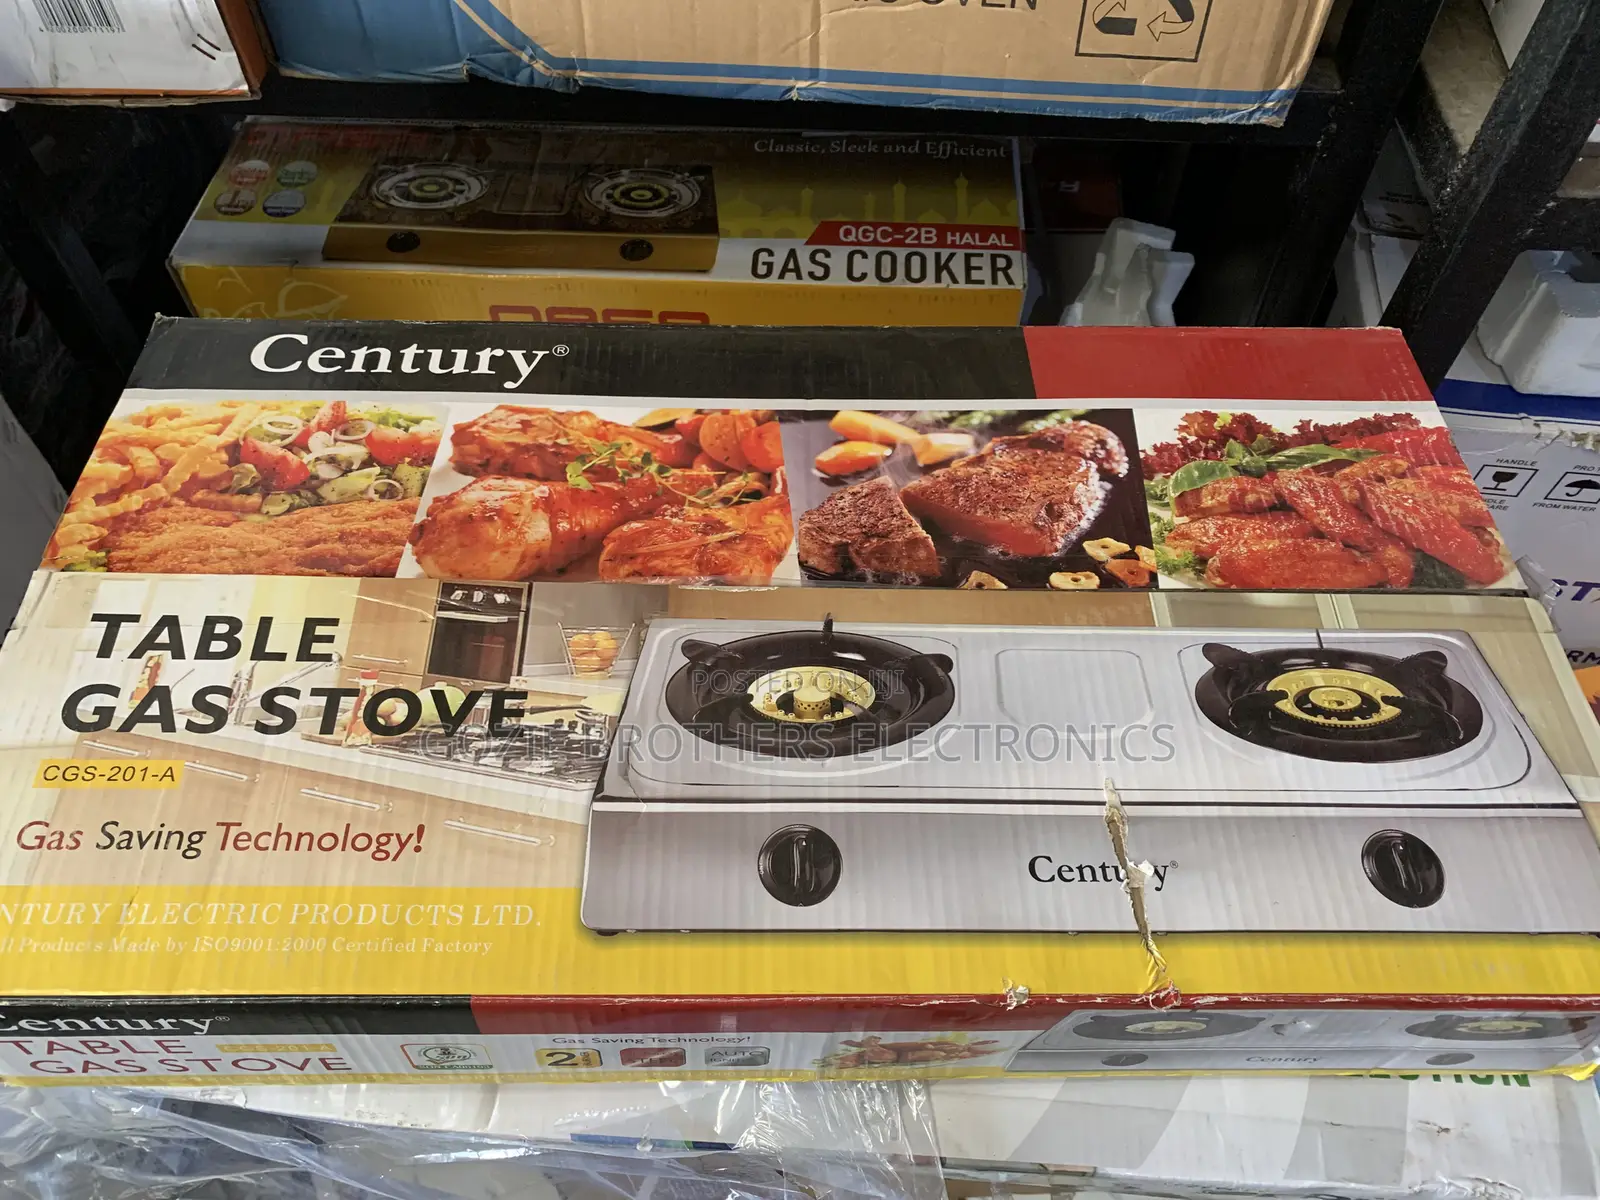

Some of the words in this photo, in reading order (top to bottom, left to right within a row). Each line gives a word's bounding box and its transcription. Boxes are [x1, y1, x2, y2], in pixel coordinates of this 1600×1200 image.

[754, 139, 827, 155] Classic,
[830, 140, 878, 154] Sleek
[886, 140, 921, 154] and
[925, 141, 1007, 159] Efficient
[838, 225, 938, 245] QGC-2B
[946, 231, 1014, 247] HALAL
[750, 247, 832, 282] GAS
[846, 249, 1016, 286] COOKER
[1496, 458, 1539, 467] HANDLE
[1532, 502, 1561, 510] FROM
[1562, 504, 1597, 512] WATER
[91, 612, 340, 663] TABLE
[60, 683, 238, 734] GAS
[254, 686, 529, 738] STOVE
[42, 763, 178, 784] CGS-201-A
[15, 820, 84, 852] Gas
[95, 820, 207, 860] Saving
[215, 821, 426, 862] Technology!
[116, 902, 282, 926] ELECTRIC
[288, 903, 465, 927] PRODUCTS
[471, 904, 542, 927] LTD.
[109, 936, 160, 953] Made
[167, 936, 188, 955] by
[192, 935, 327, 954] ISO9001:2000
[332, 936, 417, 954] Certified
[421, 936, 494, 956] Factory
[552, 1036, 586, 1045] Gas
[591, 1036, 645, 1046] Saving
[650, 1035, 751, 1046] Technology!
[29, 1058, 148, 1074] GAS
[157, 1057, 353, 1073] STOVE
[545, 1051, 579, 1067] 2
